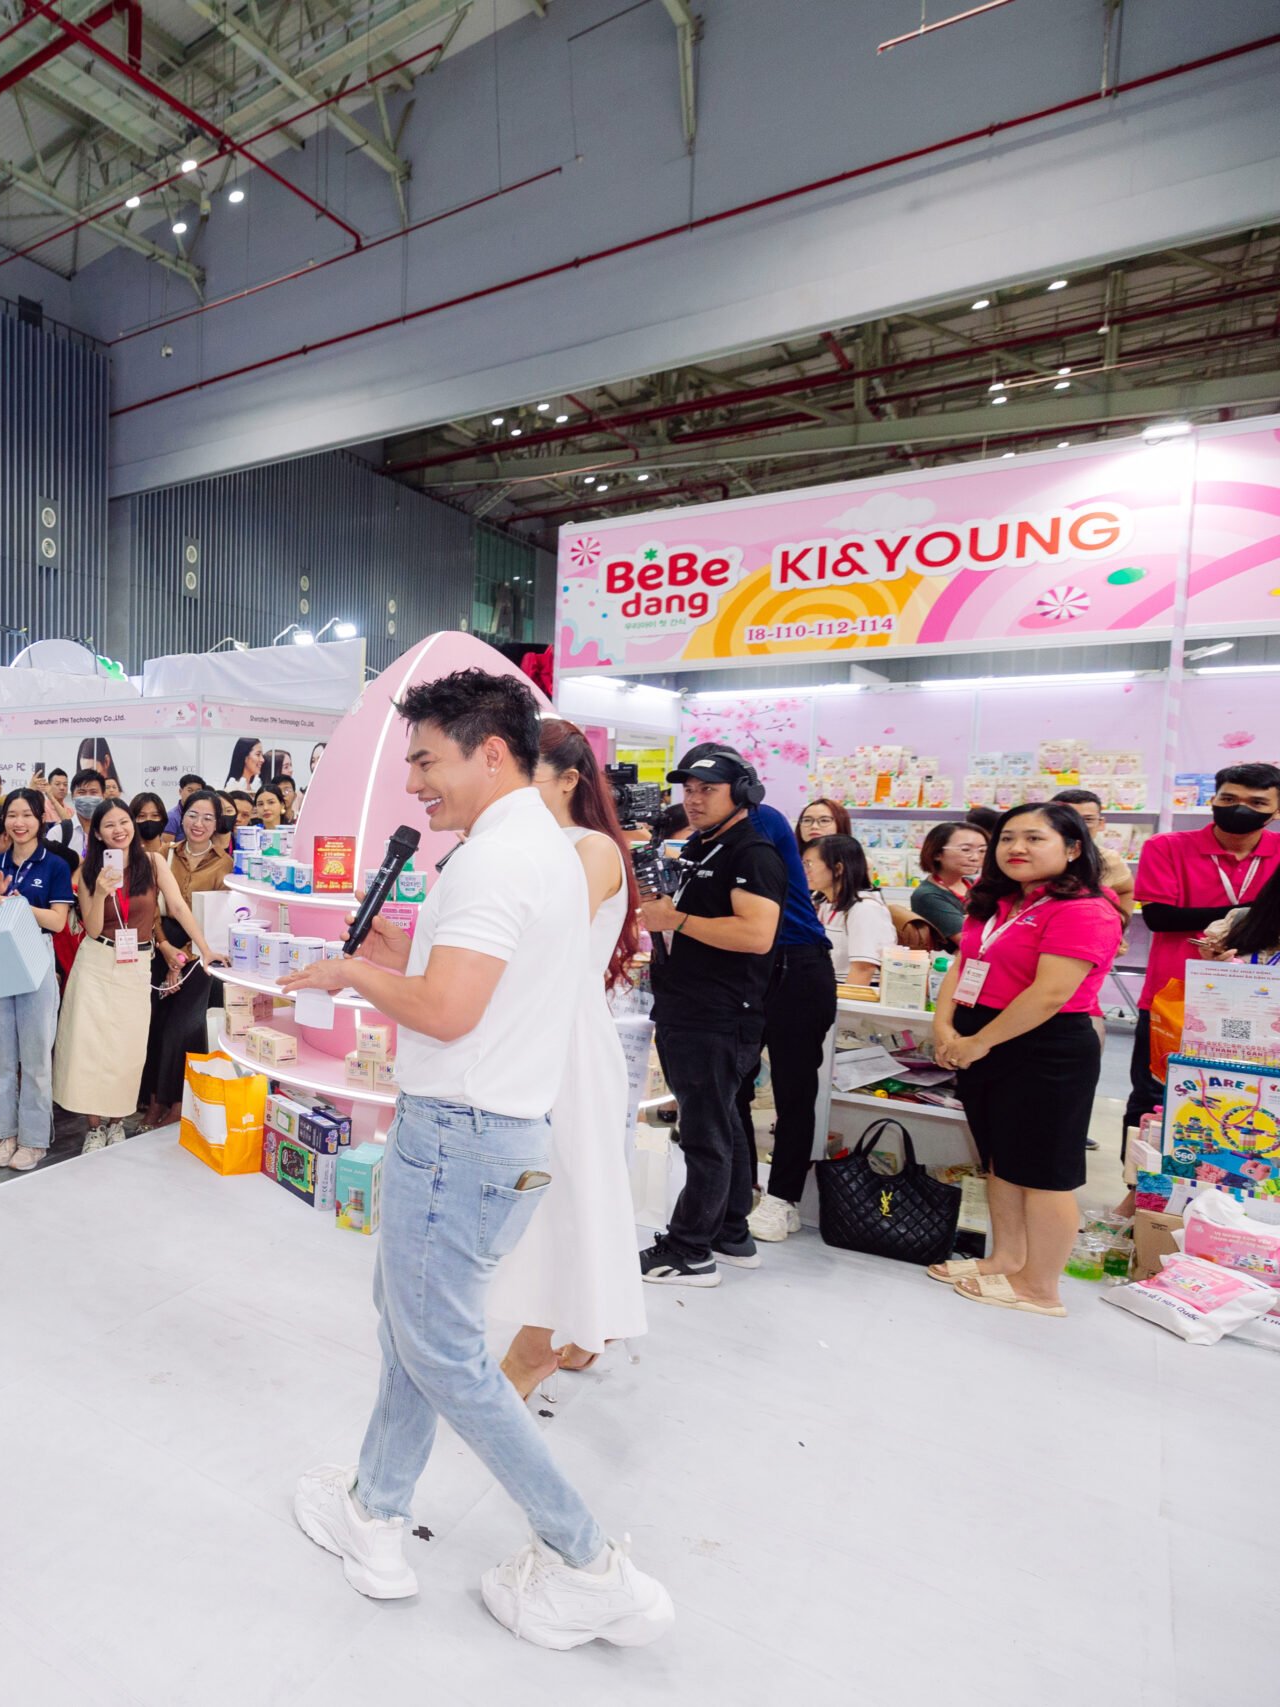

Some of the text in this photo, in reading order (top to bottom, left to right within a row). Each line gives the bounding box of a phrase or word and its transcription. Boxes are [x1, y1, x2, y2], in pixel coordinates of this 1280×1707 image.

[779, 511, 1120, 584] KI&YOUNG
[606, 552, 730, 594] BeBe
[621, 592, 709, 619] dang
[747, 616, 894, 641] I8-I10-I12-I14
